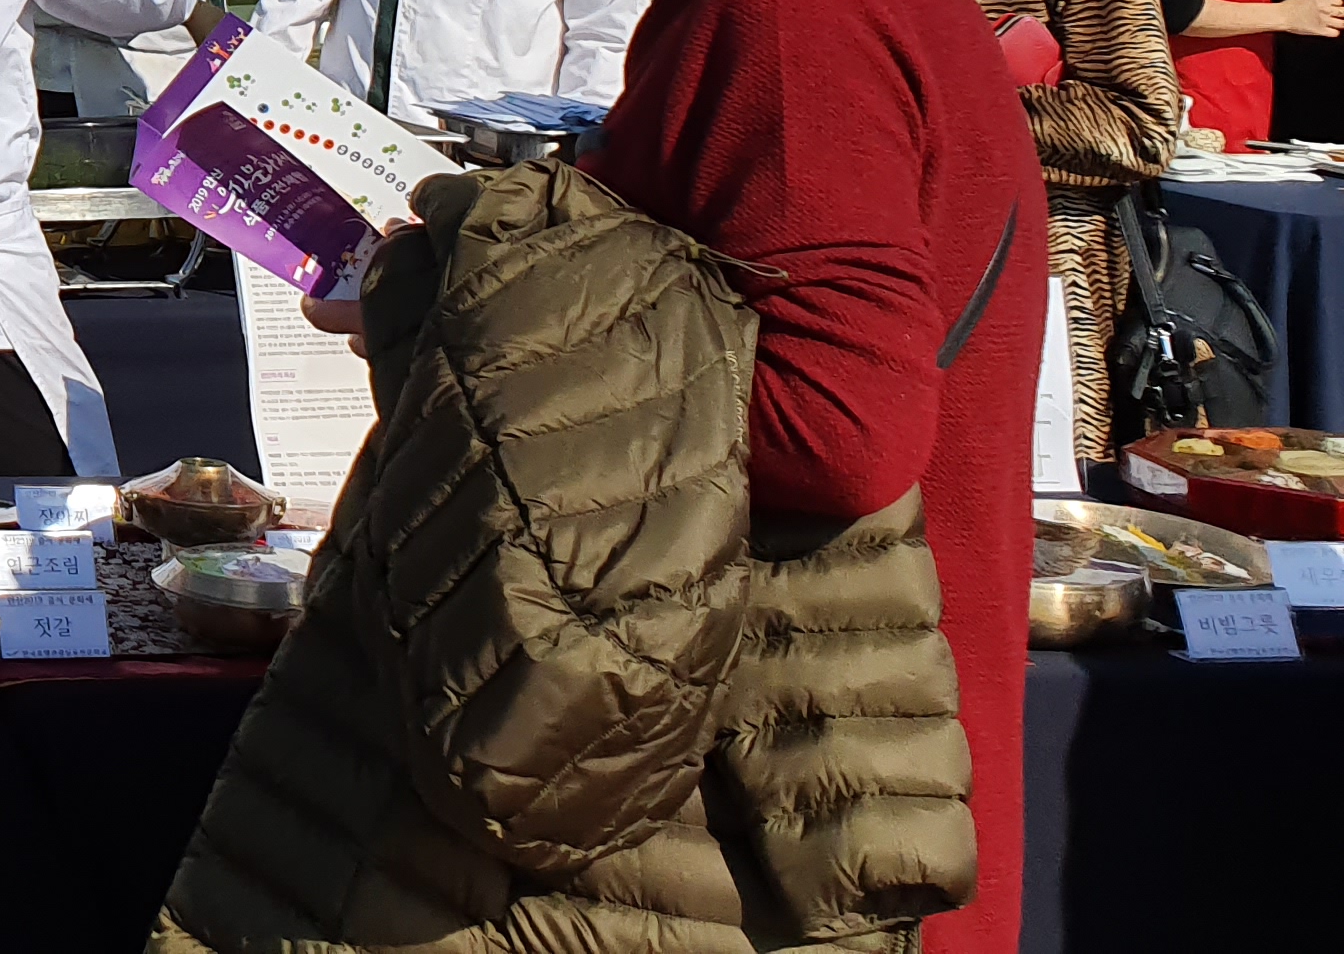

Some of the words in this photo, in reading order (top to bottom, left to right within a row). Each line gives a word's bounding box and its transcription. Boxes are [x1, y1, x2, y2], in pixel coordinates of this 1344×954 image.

[39, 508, 89, 527] 장아찌
[7, 555, 79, 576] 연근조림
[34, 616, 72, 638] 젓갈
[1198, 613, 1278, 636] 비빔그릇
